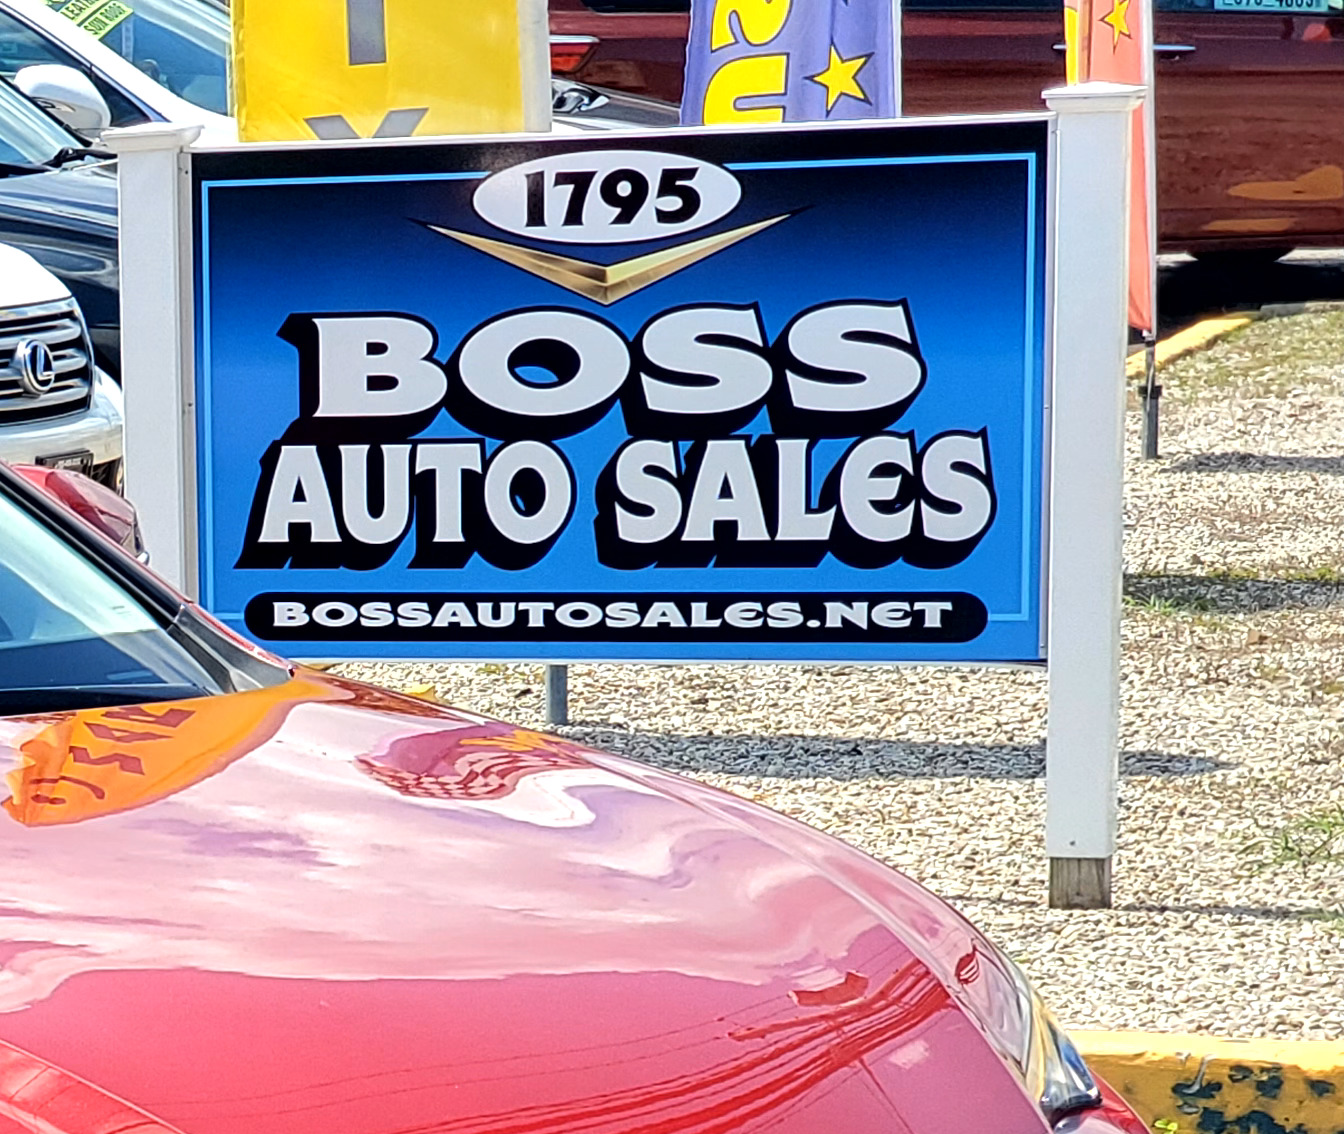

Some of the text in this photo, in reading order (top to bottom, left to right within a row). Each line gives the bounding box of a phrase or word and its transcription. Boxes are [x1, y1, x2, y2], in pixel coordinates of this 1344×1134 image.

[524, 166, 702, 228] 1795
[307, 300, 925, 419] BOSS
[254, 432, 994, 546] AUTO SALES
[272, 600, 953, 632] BOSSAUTOSALES.NET
